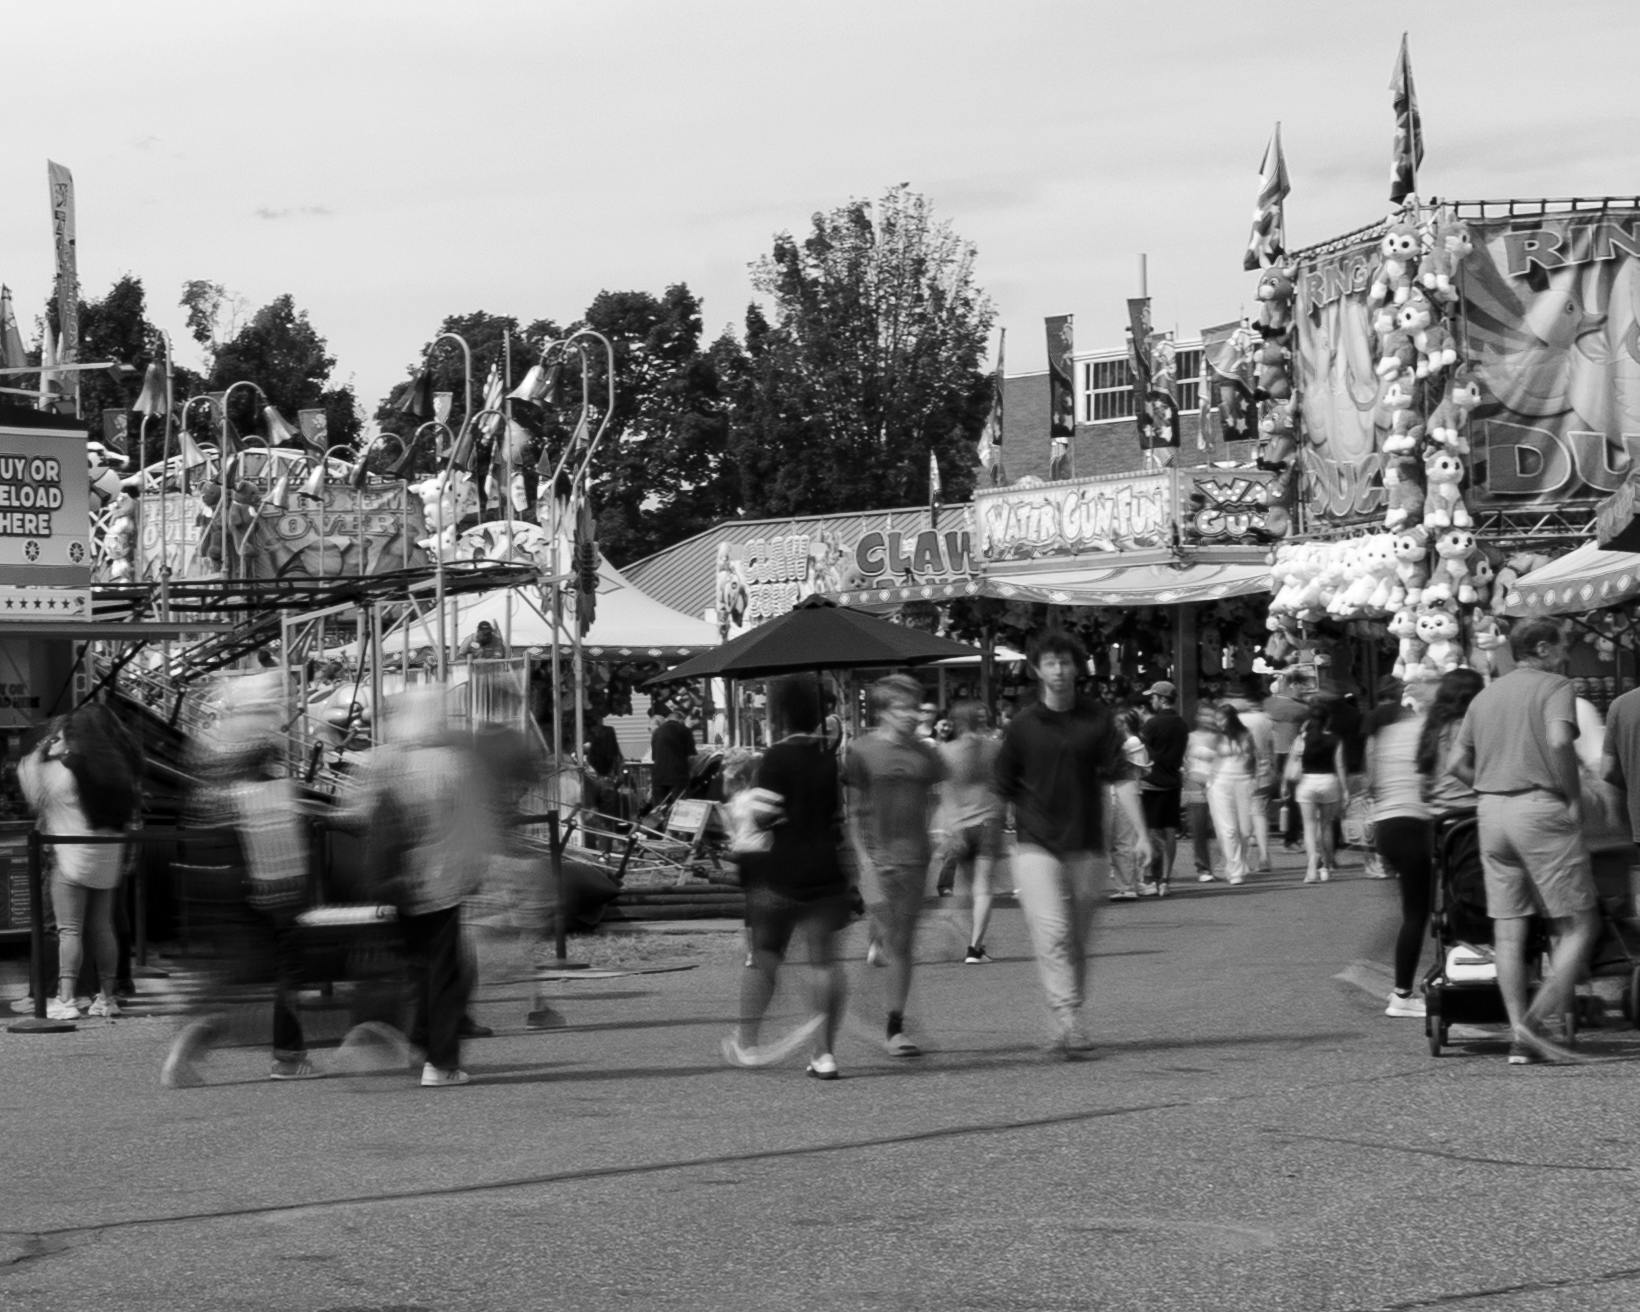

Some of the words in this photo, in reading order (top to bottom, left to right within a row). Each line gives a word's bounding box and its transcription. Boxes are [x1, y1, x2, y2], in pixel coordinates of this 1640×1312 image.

[1305, 255, 1369, 317] RING
[30, 459, 60, 482] OR
[985, 499, 1058, 546] WATER
[1062, 490, 1115, 543] GUN
[1116, 485, 1166, 538] FUN
[855, 529, 982, 577] CLAW
